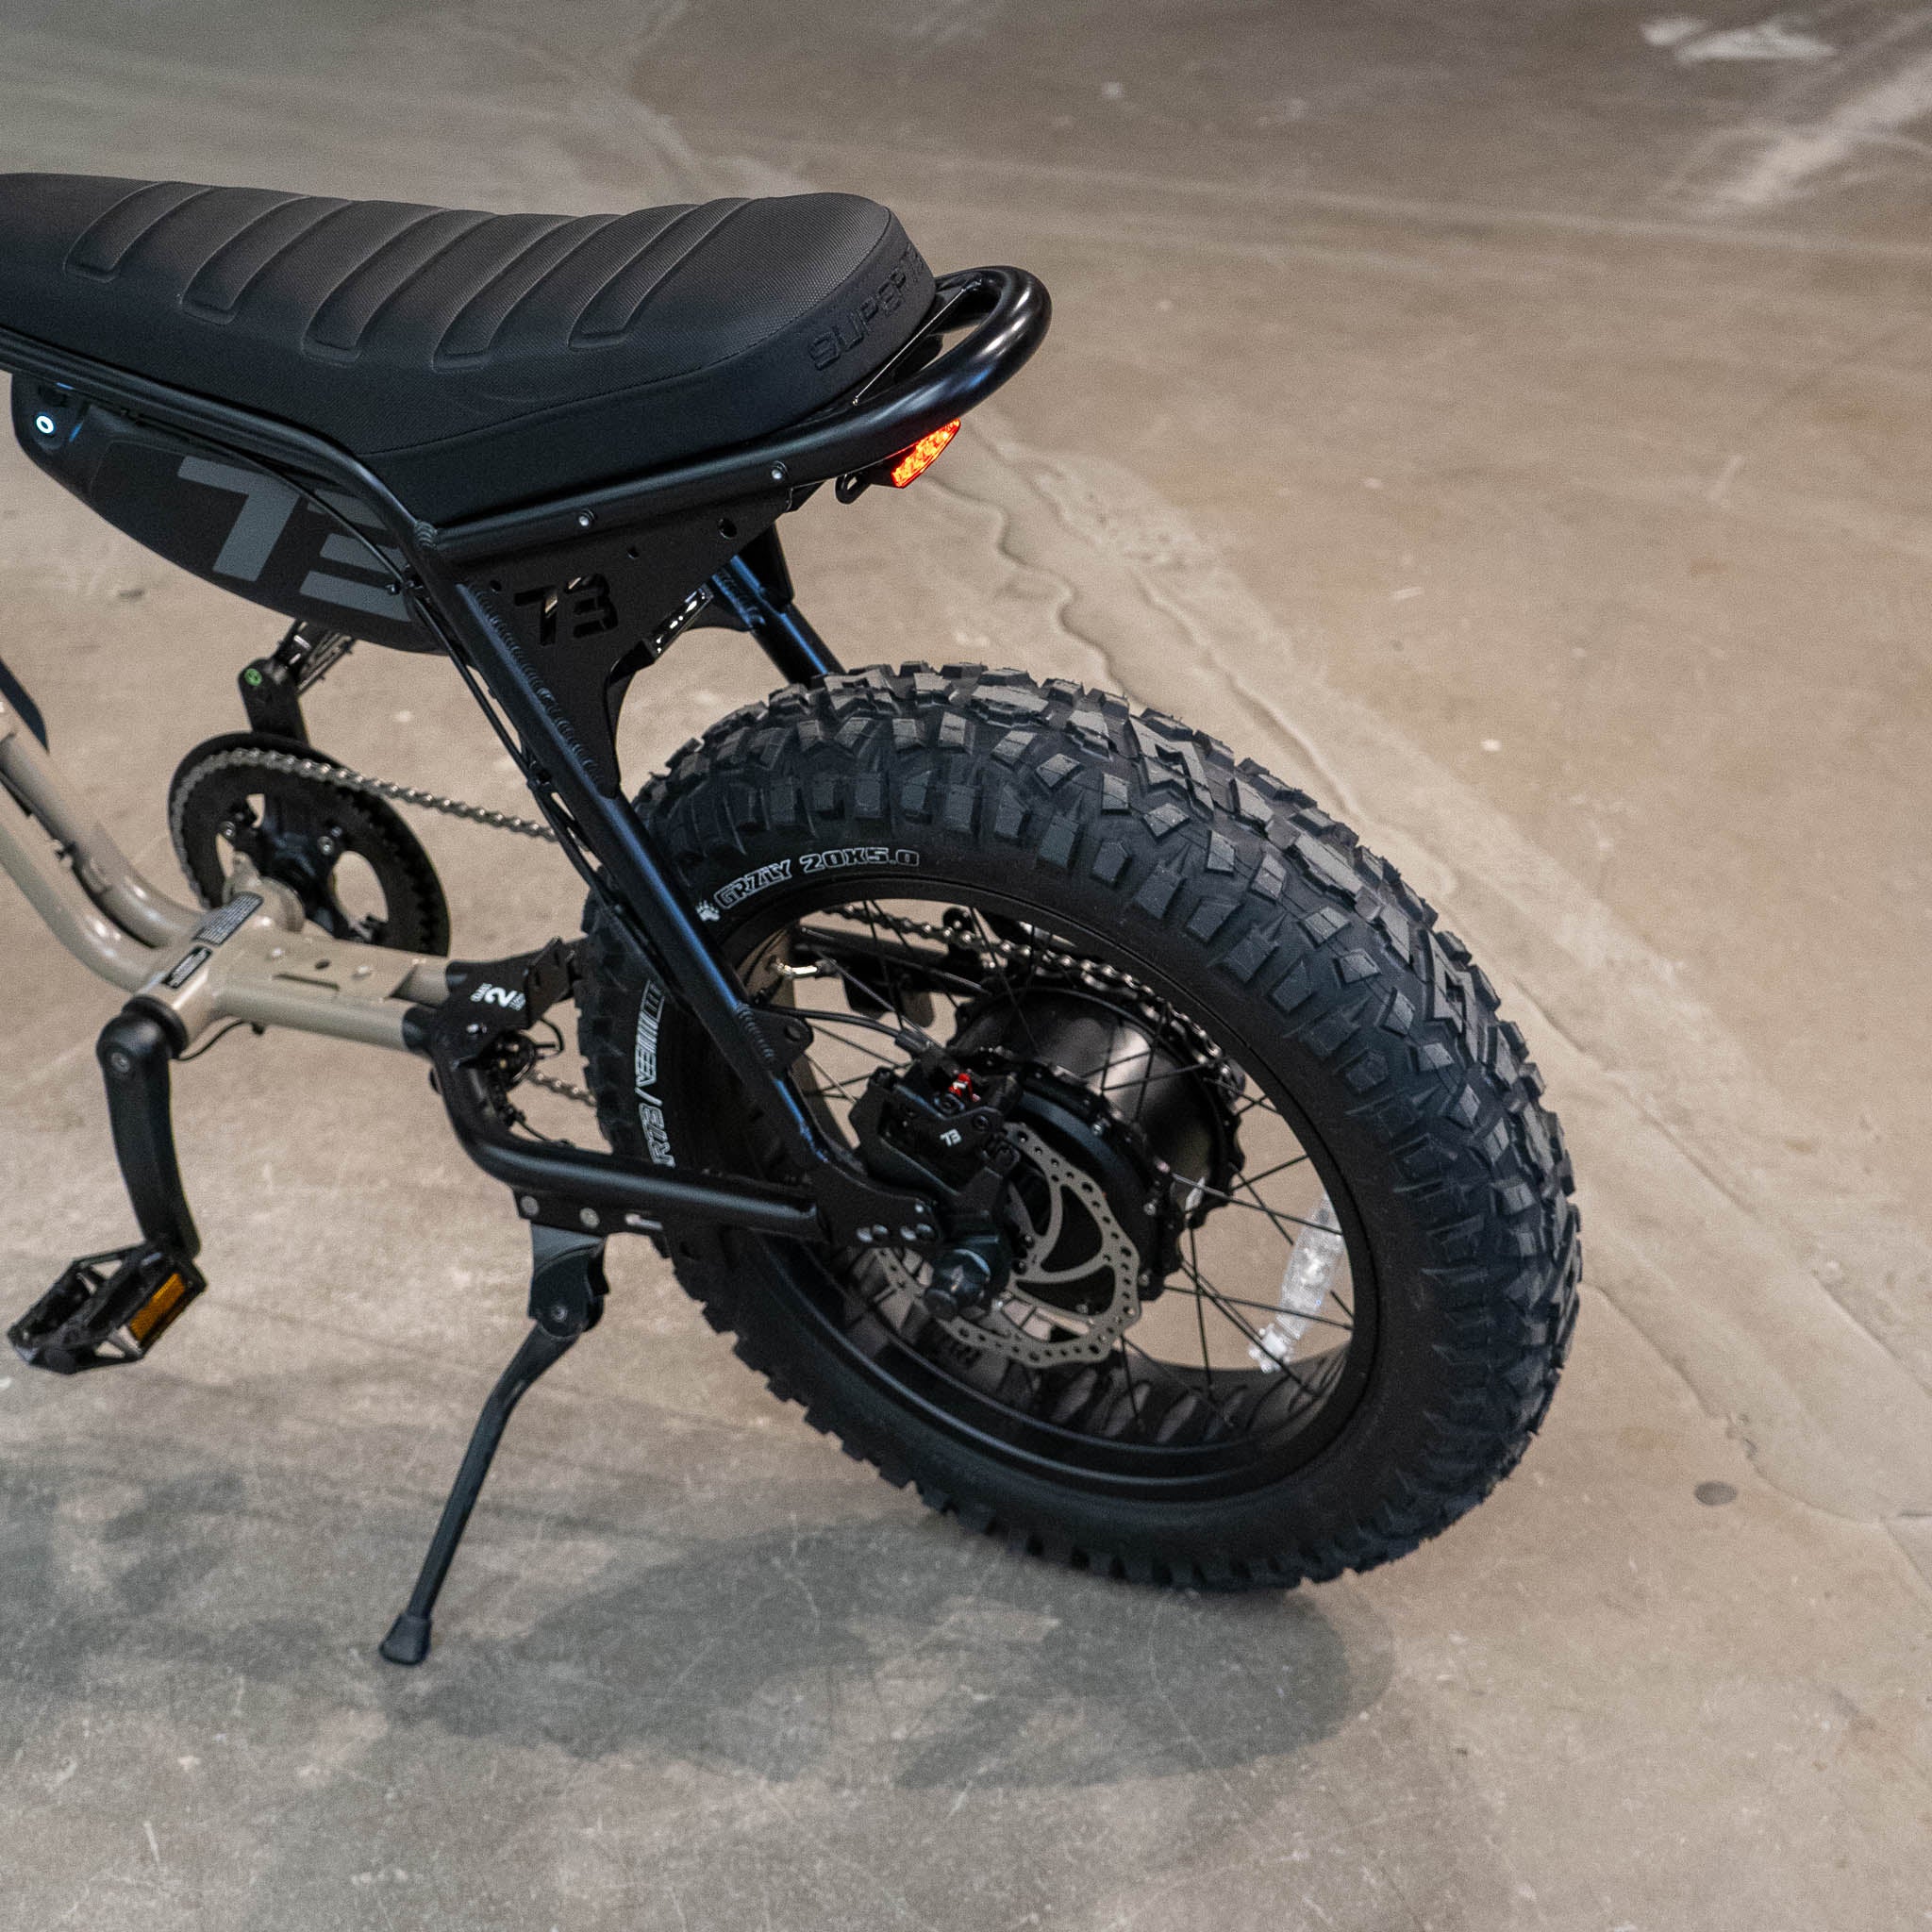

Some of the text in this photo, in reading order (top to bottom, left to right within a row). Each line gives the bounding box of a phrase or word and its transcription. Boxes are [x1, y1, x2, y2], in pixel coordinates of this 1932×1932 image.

[513, 573, 619, 646] 73
[713, 846, 920, 909] GRZLY 20X5.0
[940, 1128, 962, 1147] 73
